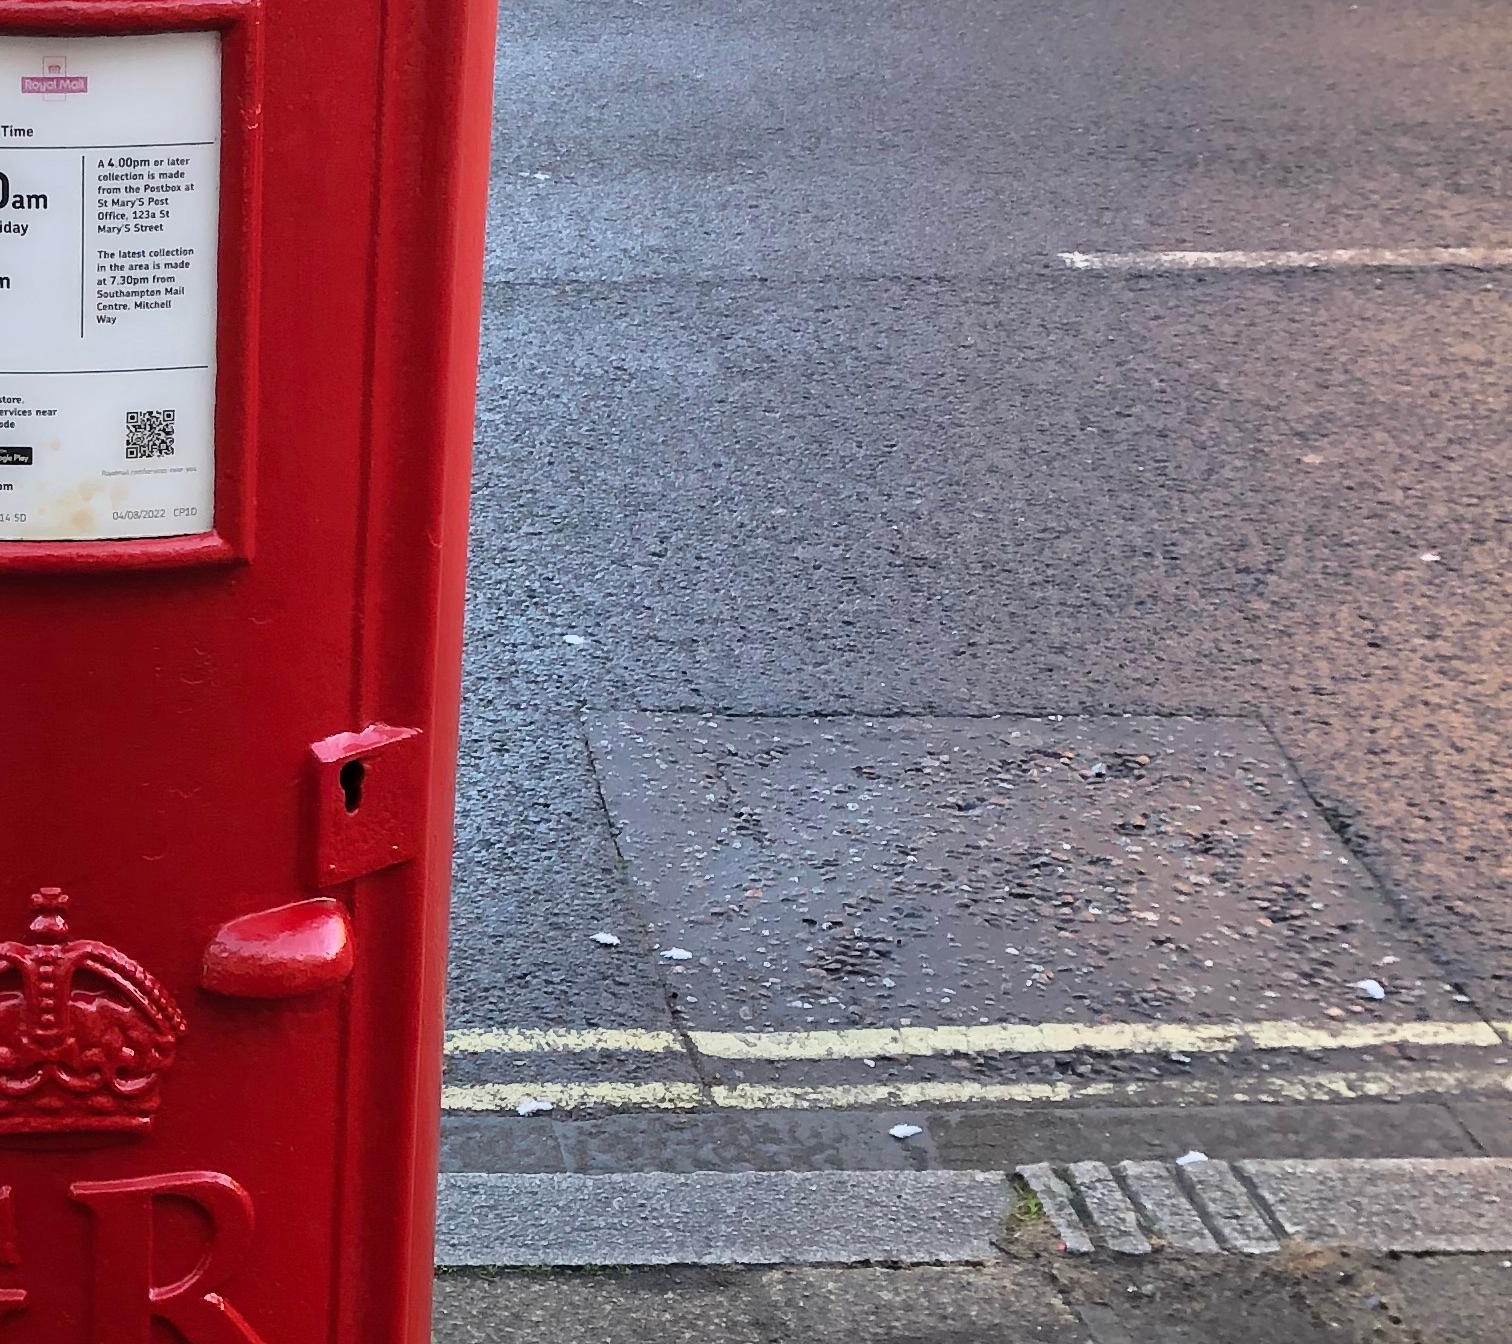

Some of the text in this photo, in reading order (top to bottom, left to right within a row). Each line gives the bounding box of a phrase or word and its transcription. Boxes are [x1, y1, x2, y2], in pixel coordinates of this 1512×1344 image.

[24, 79, 84, 92] Royal Mail
[1, 125, 33, 137] Time
[98, 160, 104, 168] A
[108, 157, 150, 169] 4.00pm
[168, 158, 190, 166] later
[98, 170, 185, 181] collection is made
[98, 186, 121, 194] from
[125, 185, 140, 193] the
[144, 184, 181, 192] Postbox
[98, 199, 108, 207] St
[148, 197, 168, 205] Post
[133, 210, 155, 219] 123a
[160, 210, 169, 218] St
[134, 224, 163, 232] Street
[97, 247, 194, 259] The latest collection
[97, 264, 106, 272] in
[110, 263, 125, 271] the
[153, 261, 160, 269] is
[164, 260, 190, 269] made
[97, 275, 175, 286] at 7.30pm from
[97, 287, 184, 298] Southampton Mail
[135, 300, 171, 309] Mitchell
[97, 315, 116, 324] Way
[14, 454, 29, 462] Play
